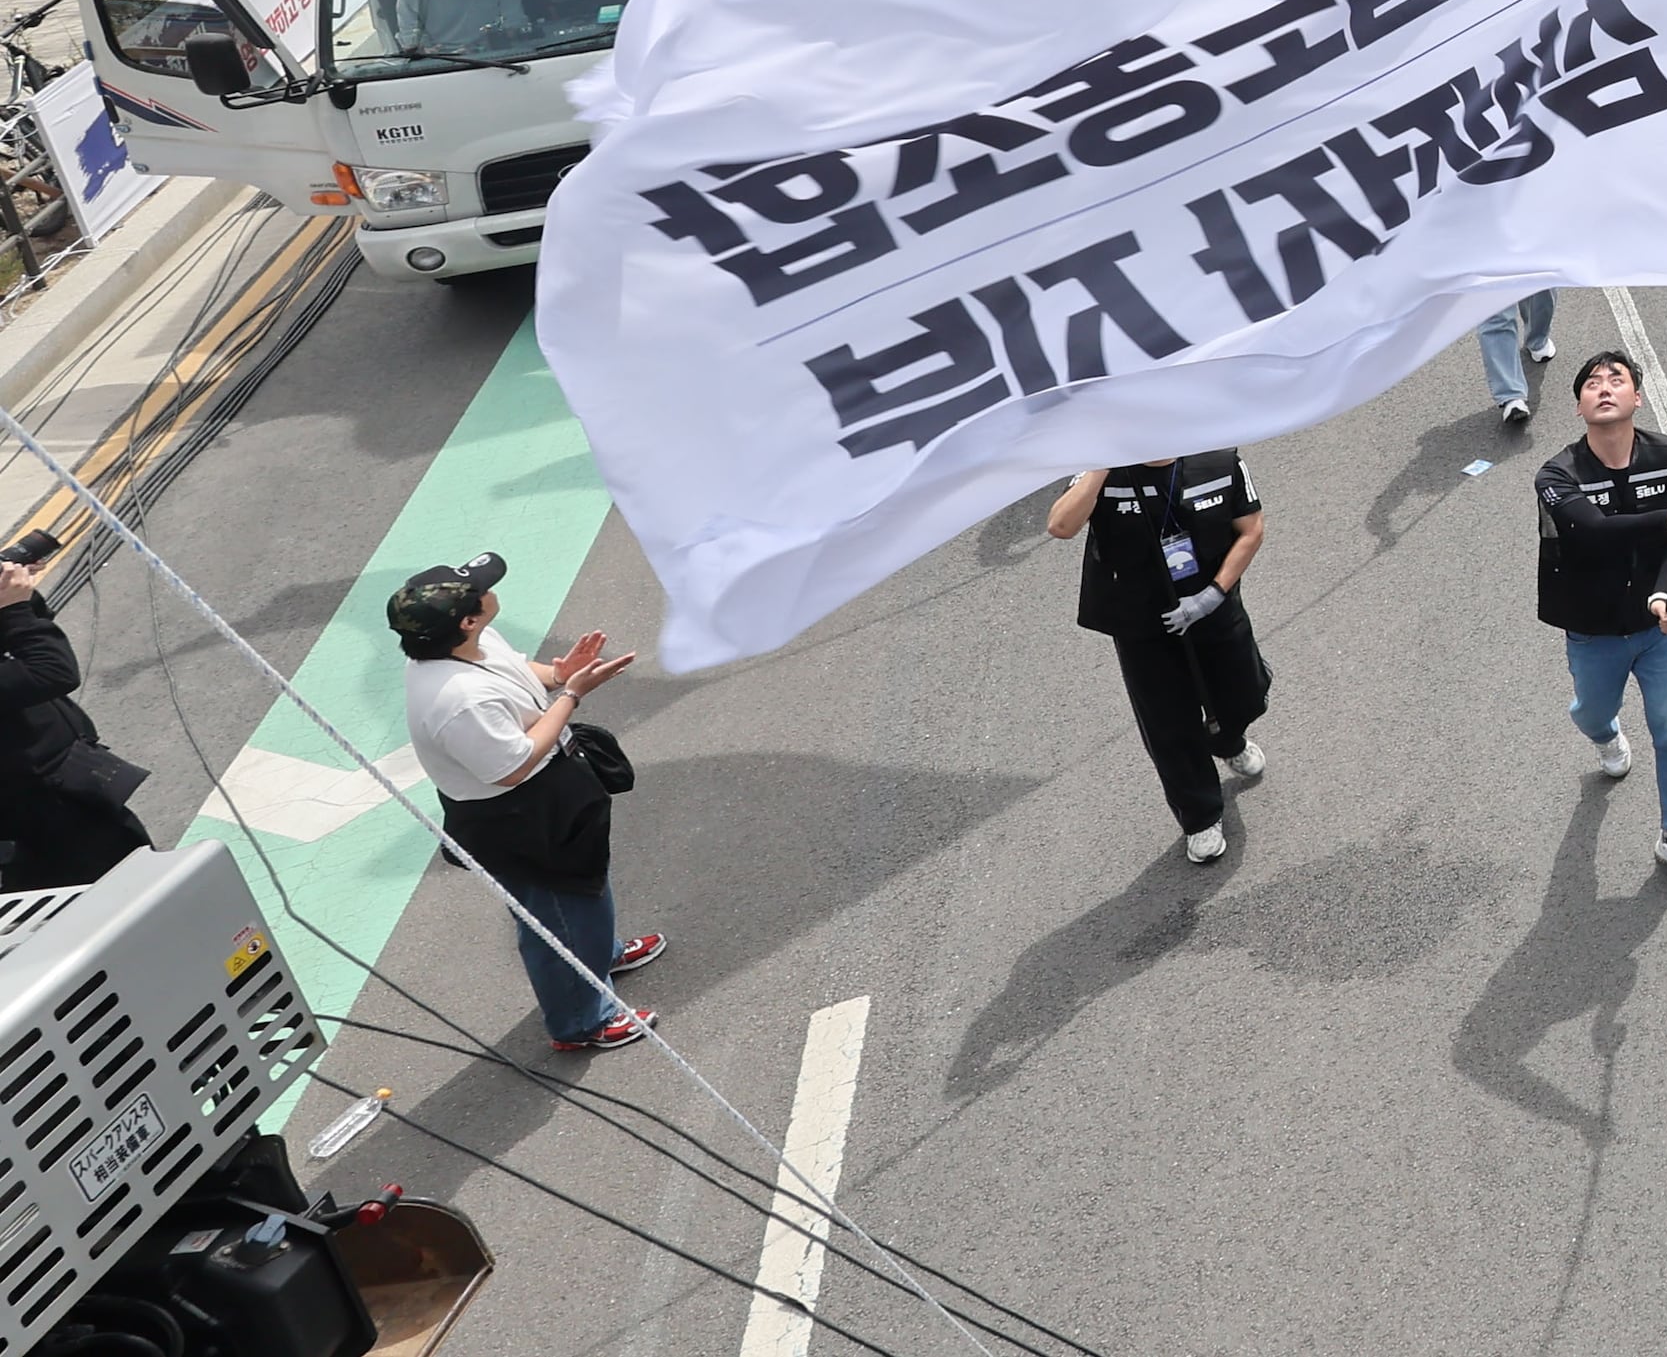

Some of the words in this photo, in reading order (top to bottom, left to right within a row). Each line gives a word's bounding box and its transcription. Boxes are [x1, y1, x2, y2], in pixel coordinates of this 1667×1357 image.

[376, 125, 423, 140] KGTU
[1636, 486, 1666, 499] SELU
[1194, 495, 1223, 511] SELU
[74, 1099, 150, 1179] スパークアレスタ
[93, 1125, 150, 1184] 相当装備車
